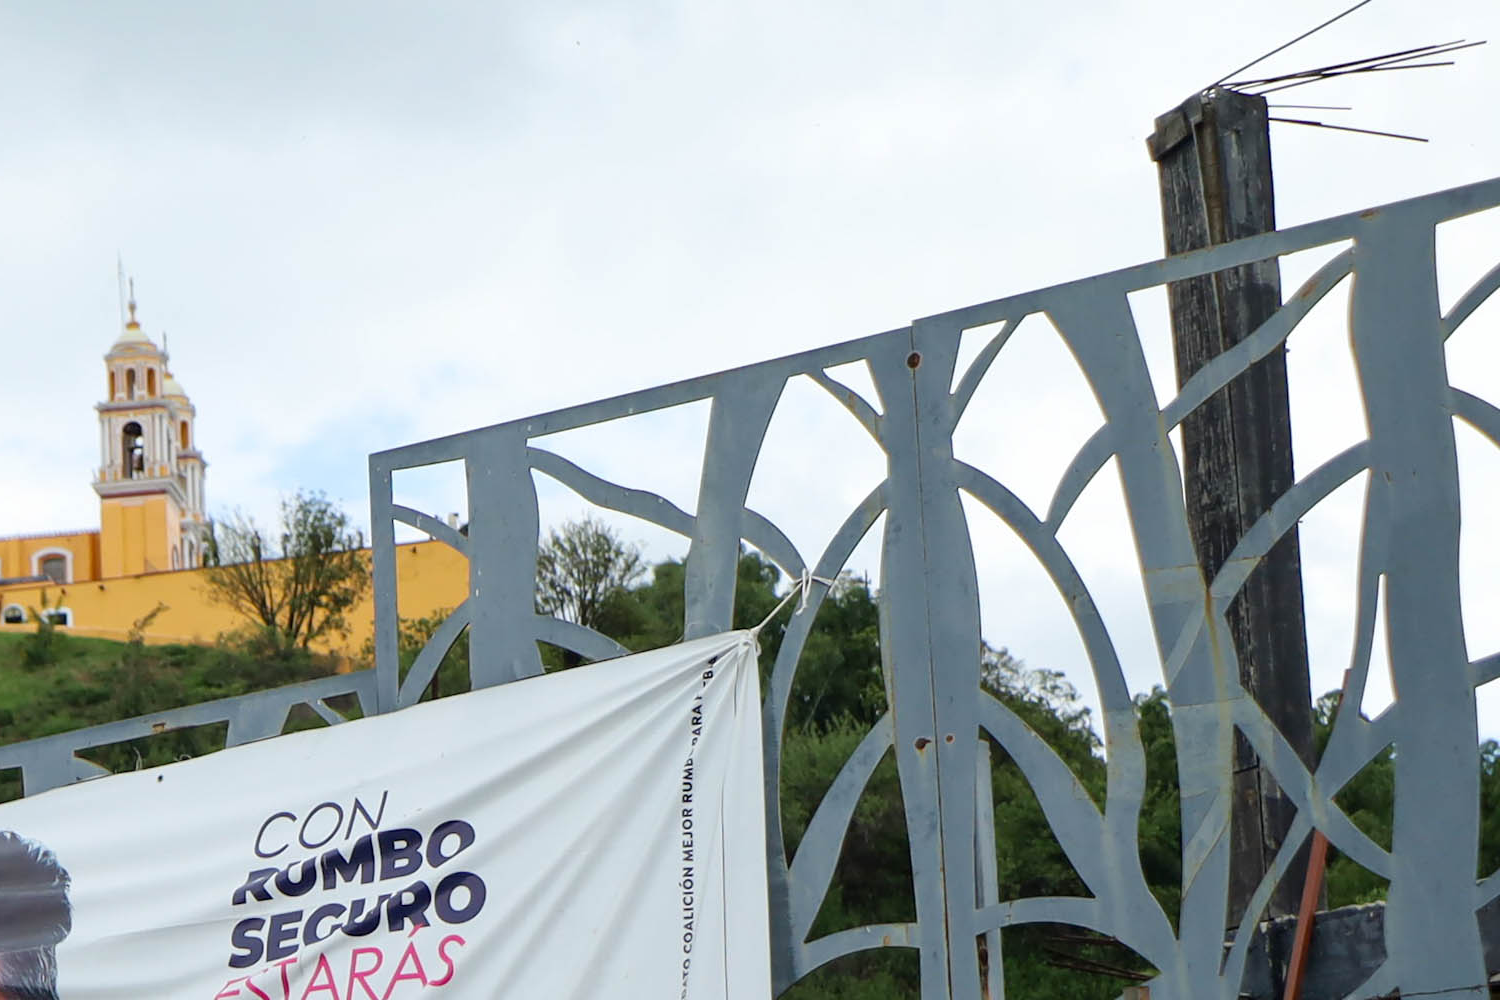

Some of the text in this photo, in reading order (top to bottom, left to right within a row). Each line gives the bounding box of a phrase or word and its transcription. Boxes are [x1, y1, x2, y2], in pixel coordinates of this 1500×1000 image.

[681, 749, 696, 803] RUMB
[231, 819, 476, 906] RUMBO
[253, 789, 389, 859] CON
[681, 807, 695, 862] MEJOR
[228, 871, 487, 969] SEGURO
[678, 866, 695, 954] COALICIÓN
